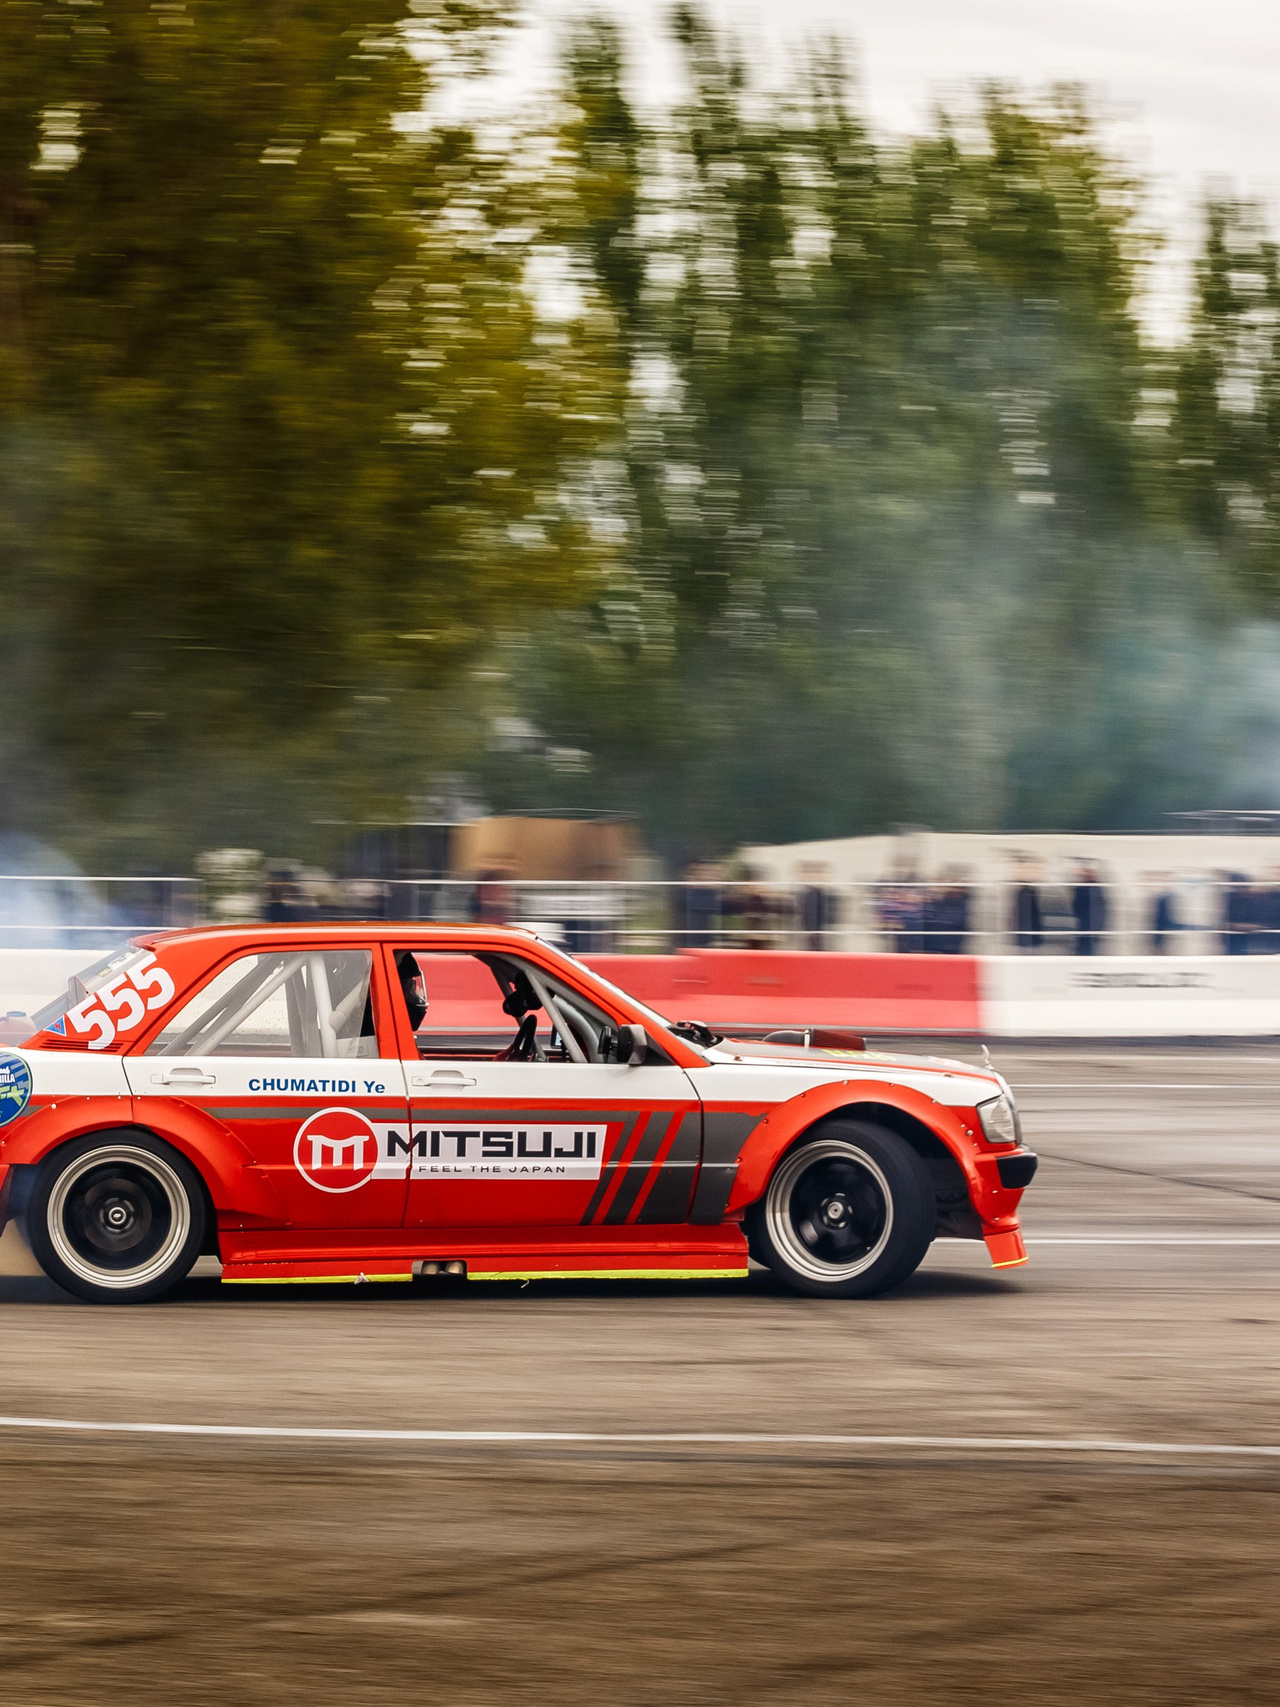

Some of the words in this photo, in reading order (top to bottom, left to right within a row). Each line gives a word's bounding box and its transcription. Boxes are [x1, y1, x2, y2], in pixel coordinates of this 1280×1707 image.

[66, 953, 175, 1050] 555
[248, 1078, 356, 1093] CHUMATIDI
[363, 1080, 386, 1093] Ye
[387, 1130, 596, 1158] MITSUJI
[418, 1165, 463, 1173] FEEL
[470, 1165, 502, 1173] THE
[508, 1165, 566, 1173] JAPAN
